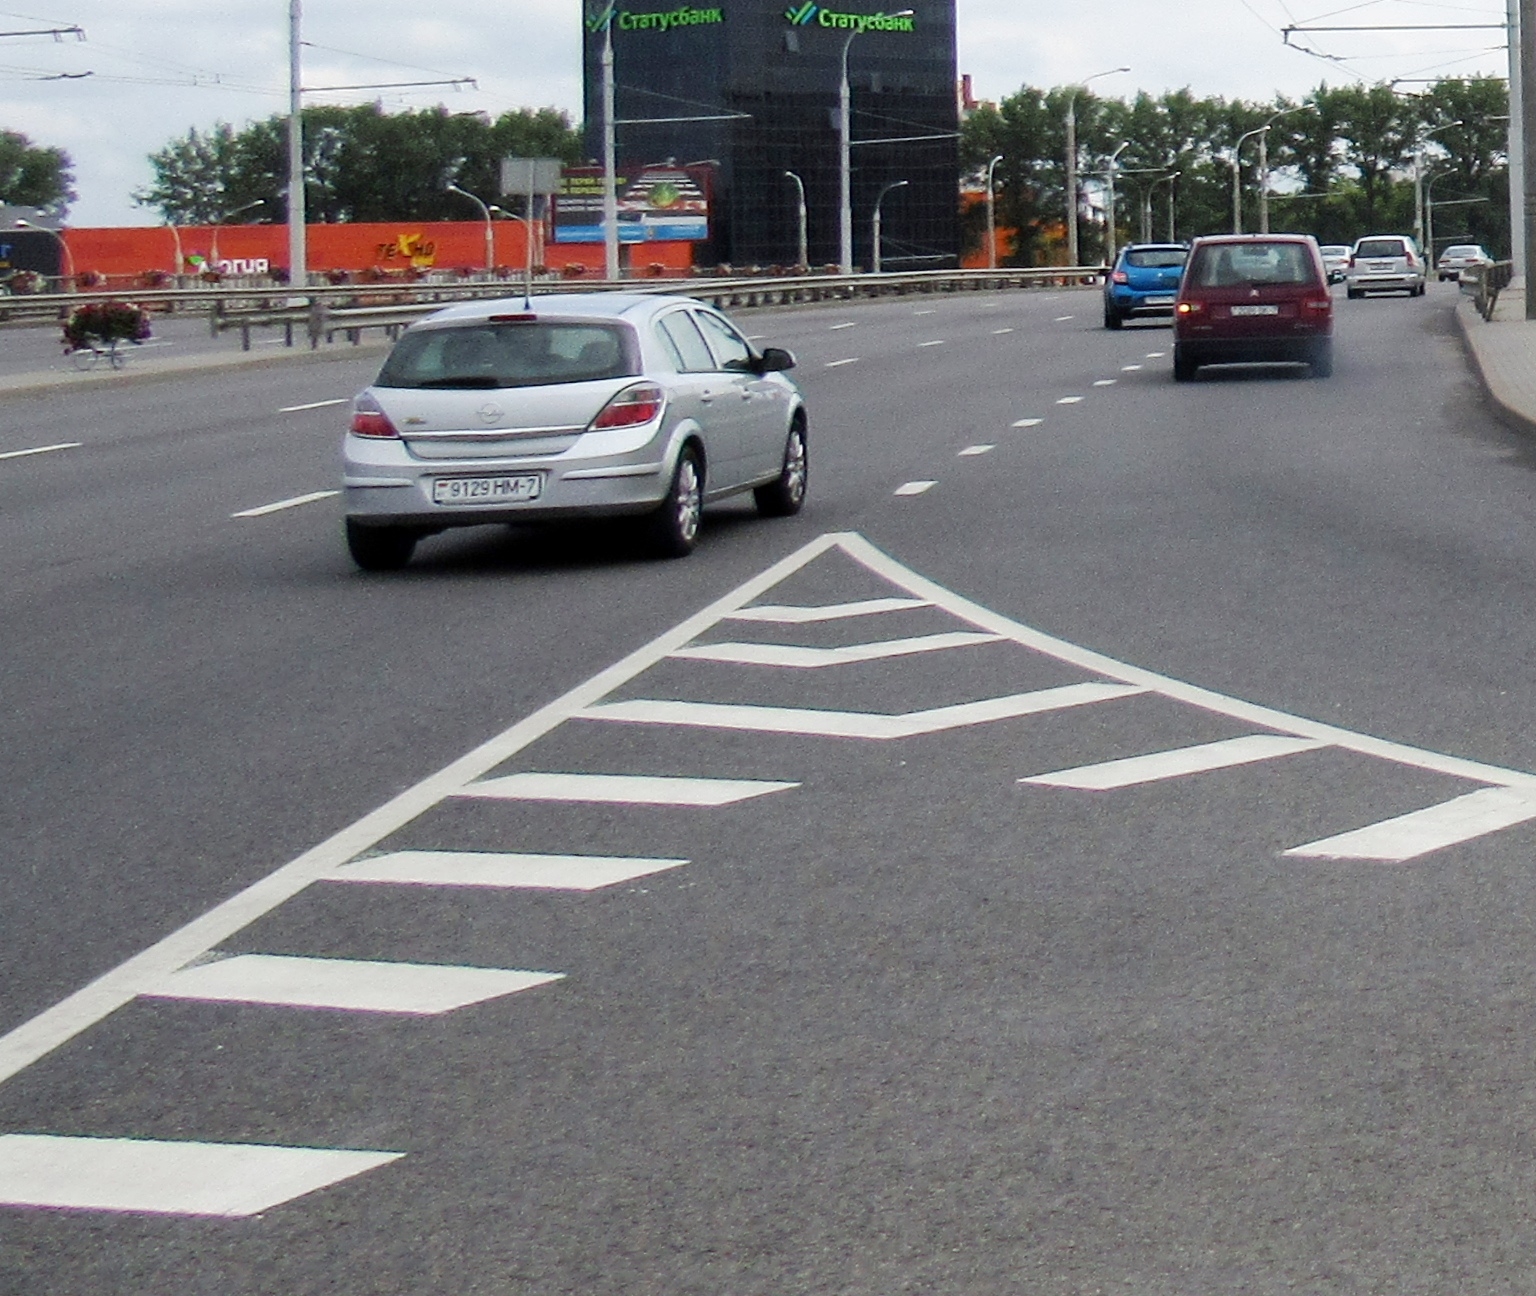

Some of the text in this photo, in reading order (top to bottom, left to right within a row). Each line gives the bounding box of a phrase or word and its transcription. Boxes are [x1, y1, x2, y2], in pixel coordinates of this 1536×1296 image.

[619, 6, 723, 32] Статусбанк
[818, 8, 915, 33] Статусбанк
[451, 478, 535, 497] 9129 HM-7
